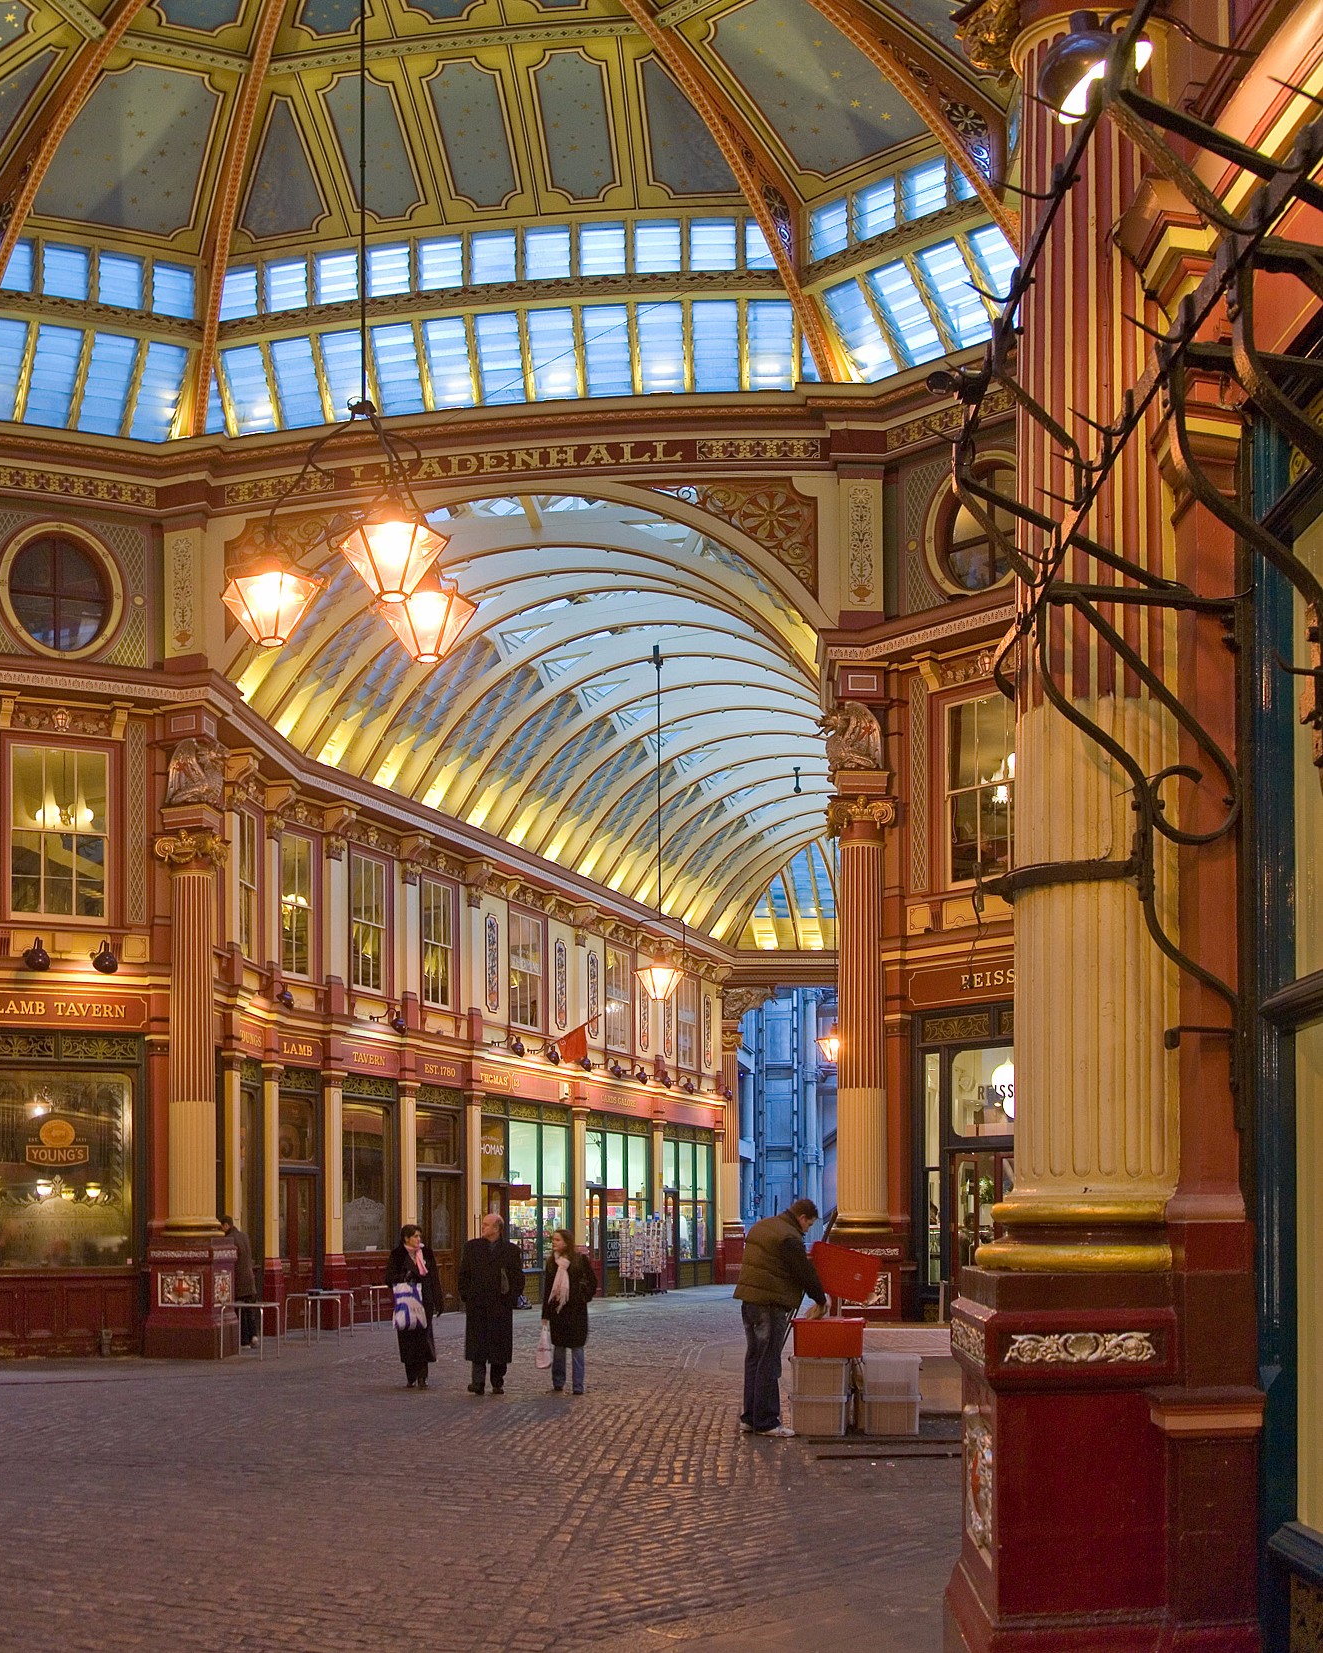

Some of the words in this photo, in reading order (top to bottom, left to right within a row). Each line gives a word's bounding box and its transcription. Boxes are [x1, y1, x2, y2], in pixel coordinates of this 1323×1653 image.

[350, 440, 683, 487] LEADENHALL
[960, 968, 1015, 990] REISS
[54, 1002, 127, 1018] TAVERN
[240, 1029, 263, 1048] OUNGS
[283, 1042, 313, 1057] LAMB
[352, 1052, 386, 1067] TAVERN
[31, 1148, 84, 1162] YOUNG'S
[481, 1144, 505, 1156] HOMAS'
